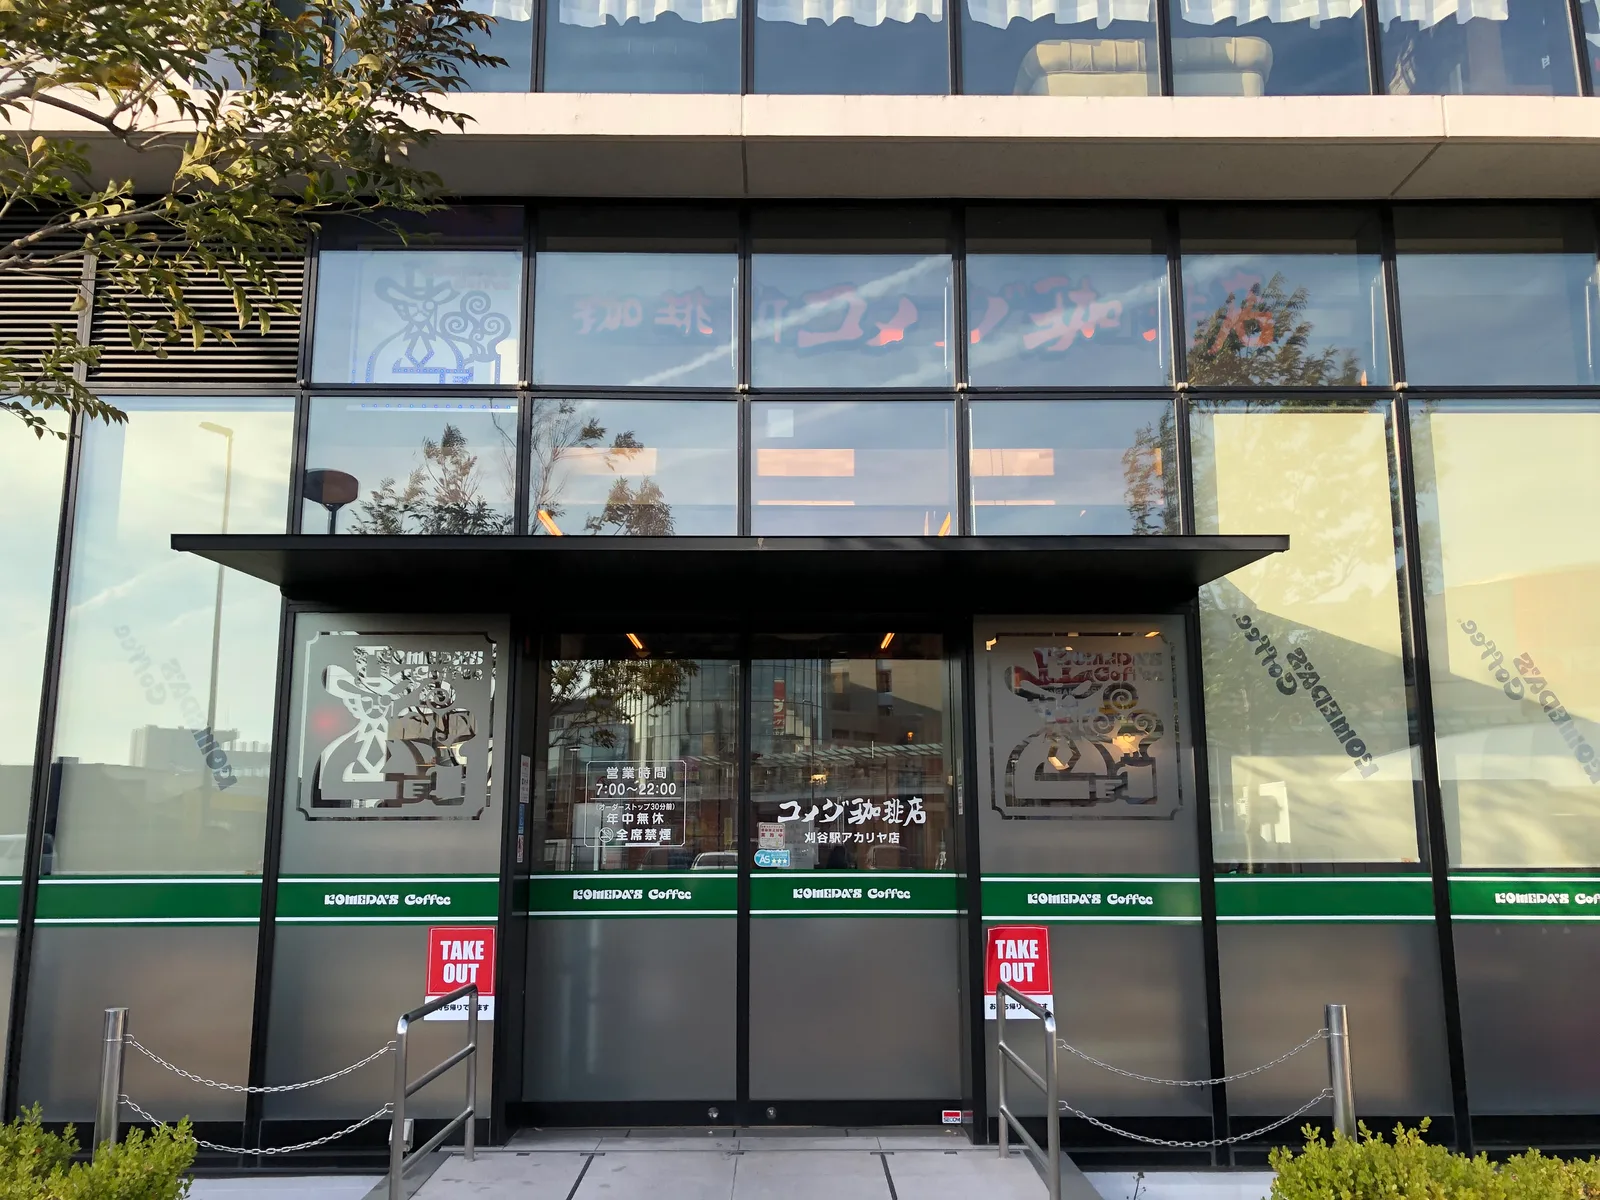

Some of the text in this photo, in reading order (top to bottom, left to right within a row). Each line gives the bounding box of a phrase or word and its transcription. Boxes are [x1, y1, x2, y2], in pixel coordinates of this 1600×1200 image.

[606, 766, 667, 779] 営業時間
[777, 796, 927, 827] コメダ珈琲店
[606, 812, 664, 825] 年中無休
[616, 828, 672, 841] 全席禁煙
[804, 832, 900, 844] 刈谷駅アカリヤ店
[324, 893, 451, 906] KOMEDA'S Coffee
[573, 889, 692, 900] KOMEDA'S Coffee
[793, 888, 911, 899] KOMEDA'S Coffee
[1027, 893, 1153, 905] KOMEDA'S Coffee
[1495, 892, 1570, 904] KOMEDA'S
[440, 940, 485, 960] TAKE
[995, 939, 1039, 960] TAKE
[443, 963, 479, 983] OUT
[999, 962, 1035, 983] OUT
